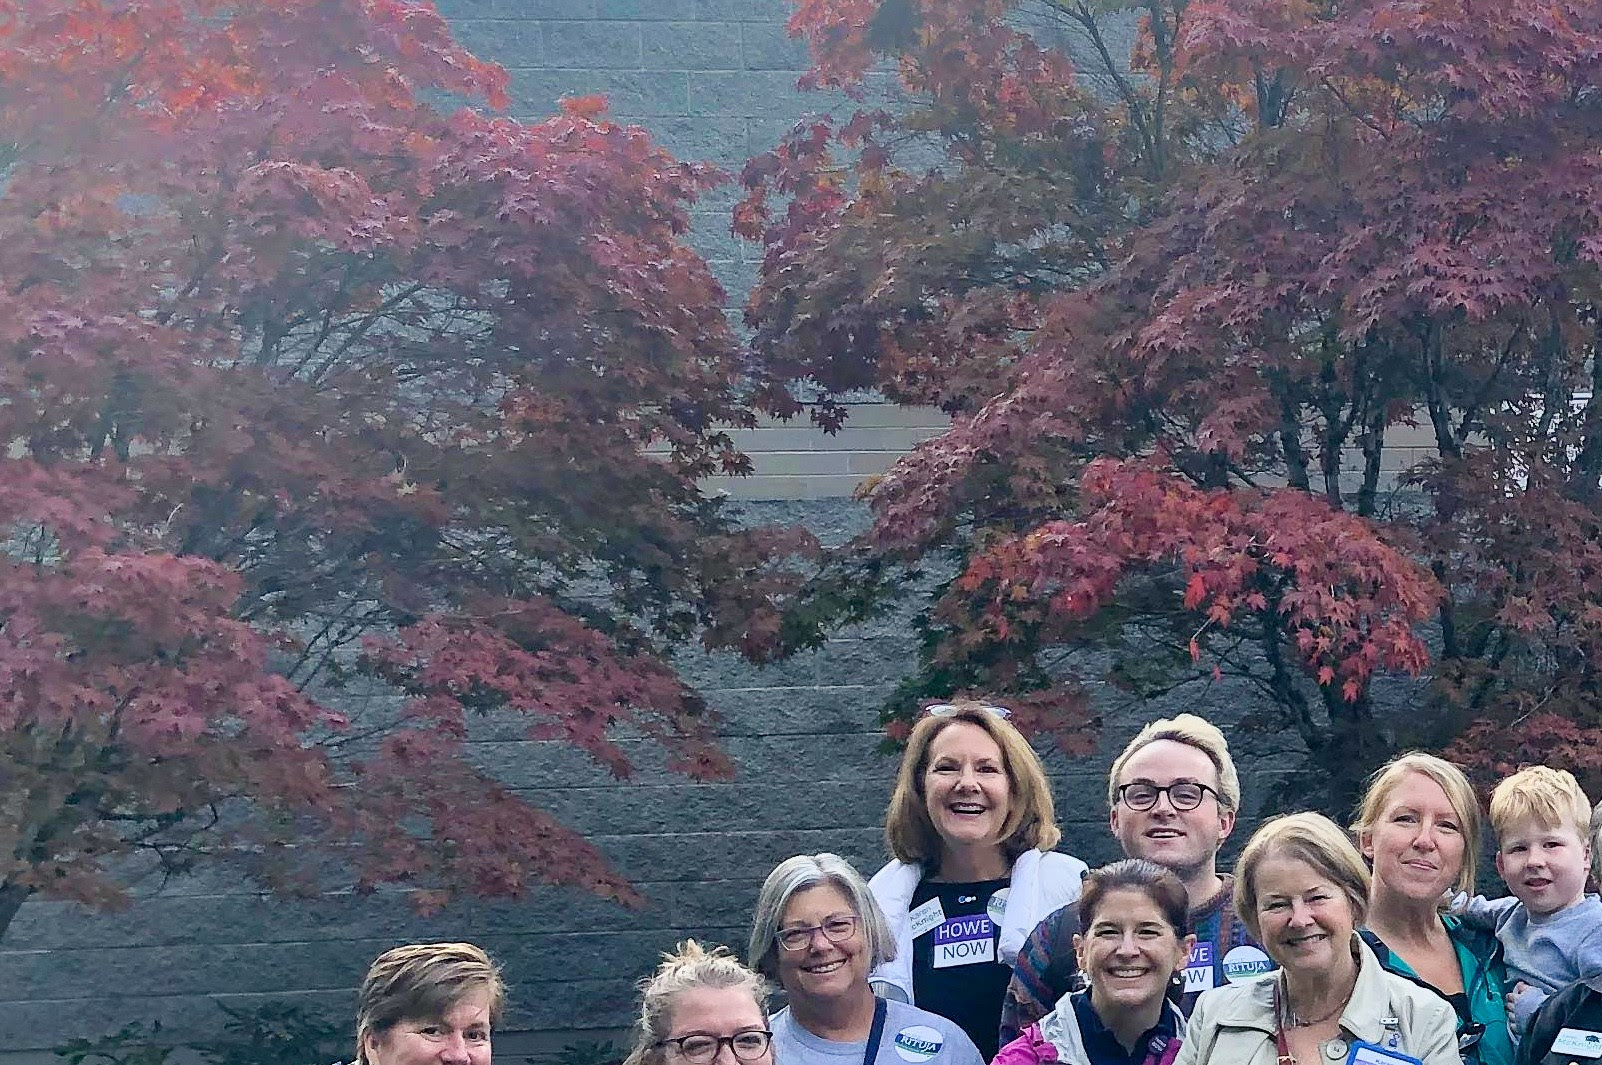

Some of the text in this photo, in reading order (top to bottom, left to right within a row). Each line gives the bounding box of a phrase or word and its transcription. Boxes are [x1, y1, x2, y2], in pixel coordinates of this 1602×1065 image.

[938, 919, 990, 939] HOWE
[943, 940, 987, 959] NOW
[1228, 961, 1267, 974] RITUJA
[900, 1033, 937, 1053] RITUJA
